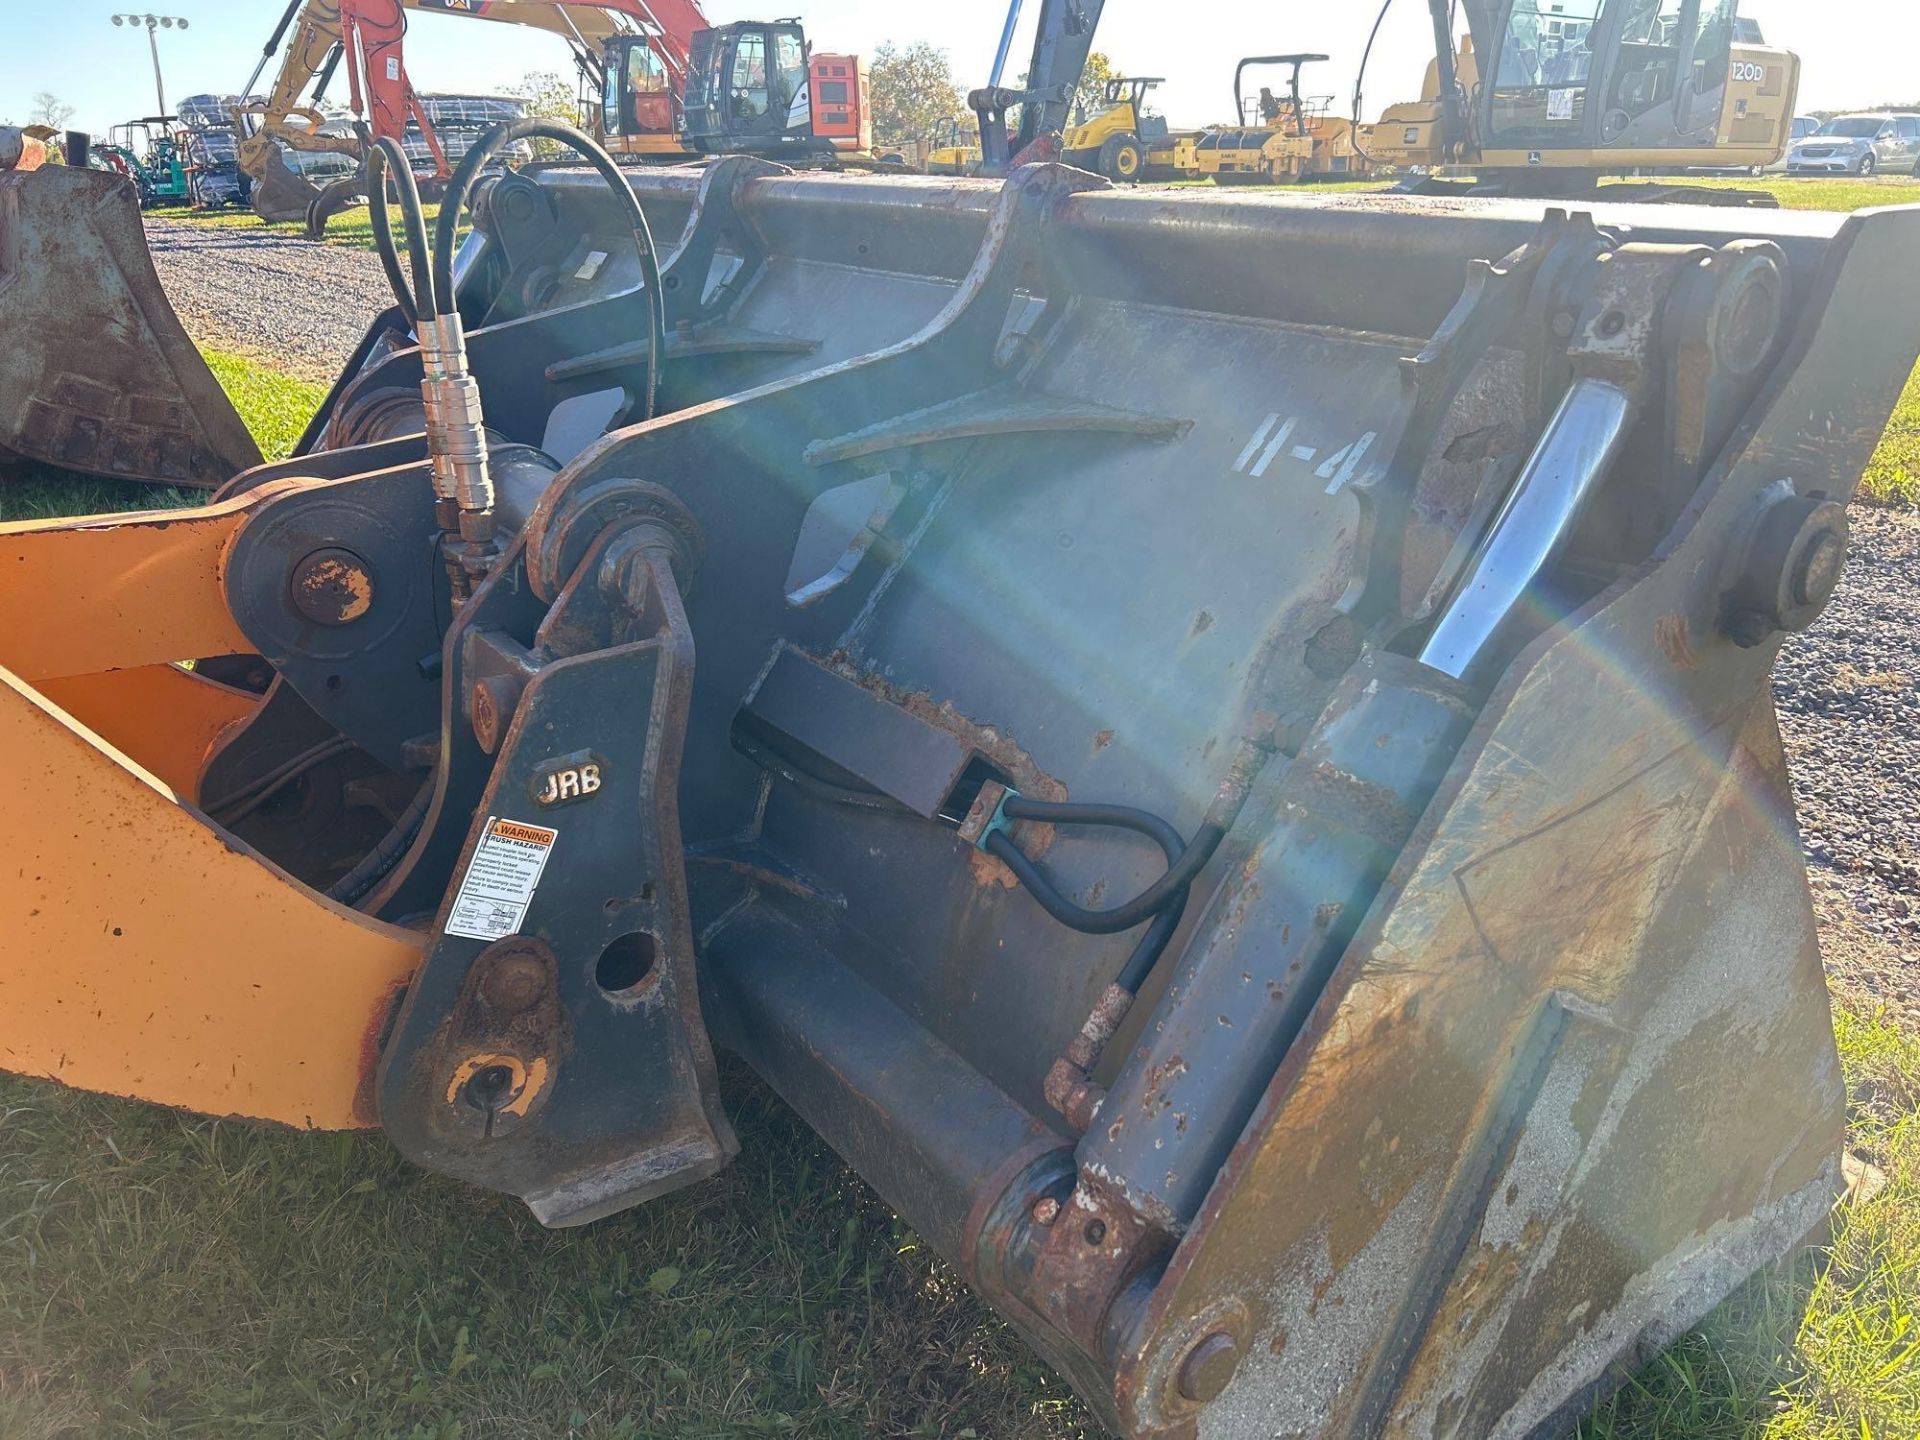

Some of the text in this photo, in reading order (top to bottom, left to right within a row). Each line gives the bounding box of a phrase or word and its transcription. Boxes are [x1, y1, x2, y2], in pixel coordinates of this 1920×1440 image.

[1731, 61, 1764, 82] 120D
[538, 764, 601, 804] JRB
[501, 825, 550, 843] WARNING
